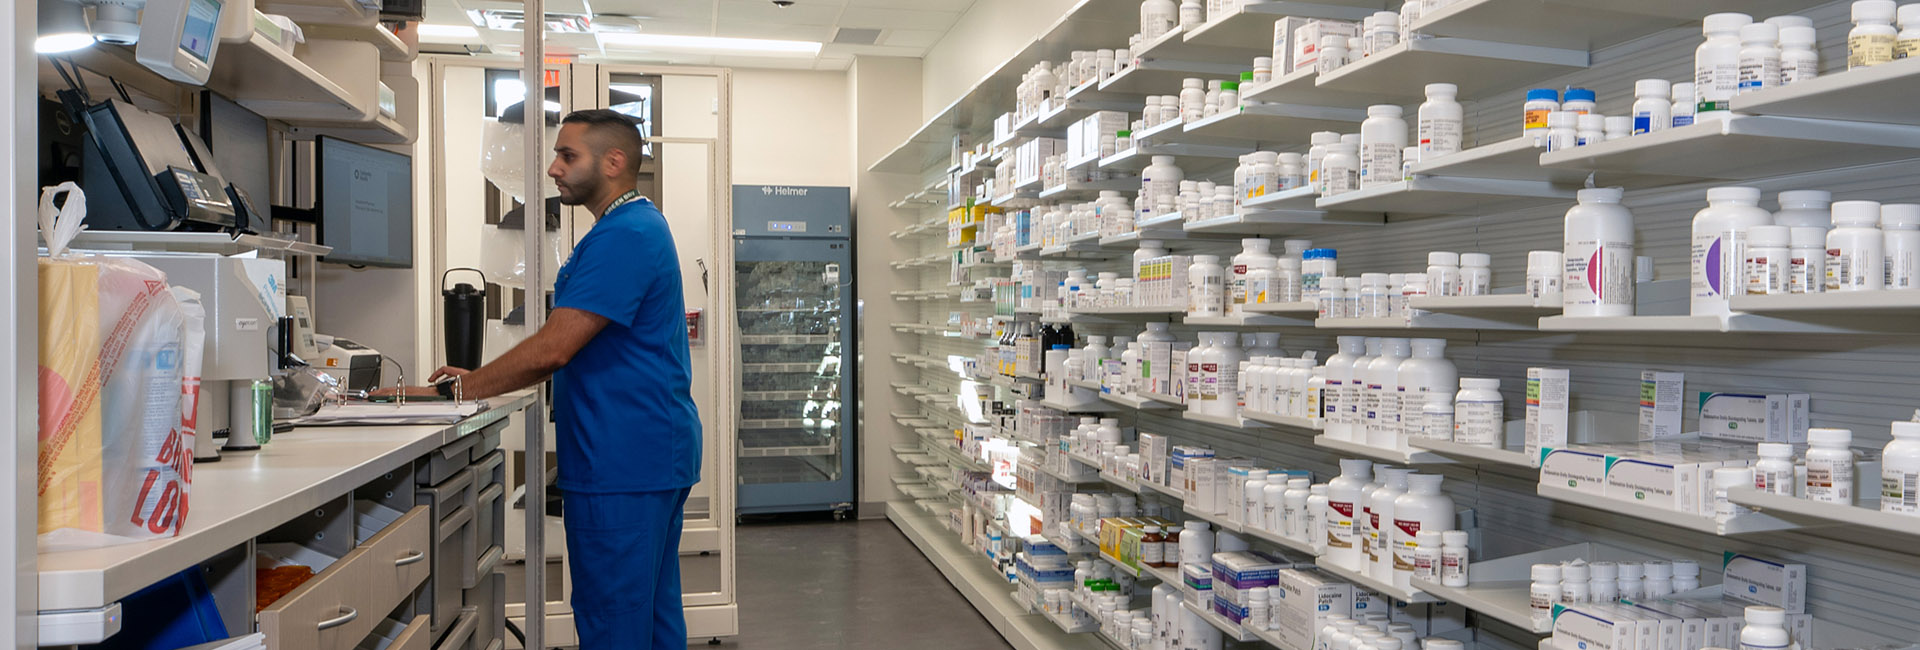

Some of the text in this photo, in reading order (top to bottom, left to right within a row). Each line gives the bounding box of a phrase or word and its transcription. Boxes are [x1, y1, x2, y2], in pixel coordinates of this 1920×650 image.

[775, 187, 808, 196] Helmer
[604, 190, 635, 216] GREEN BAY
[267, 273, 278, 295] 3M
